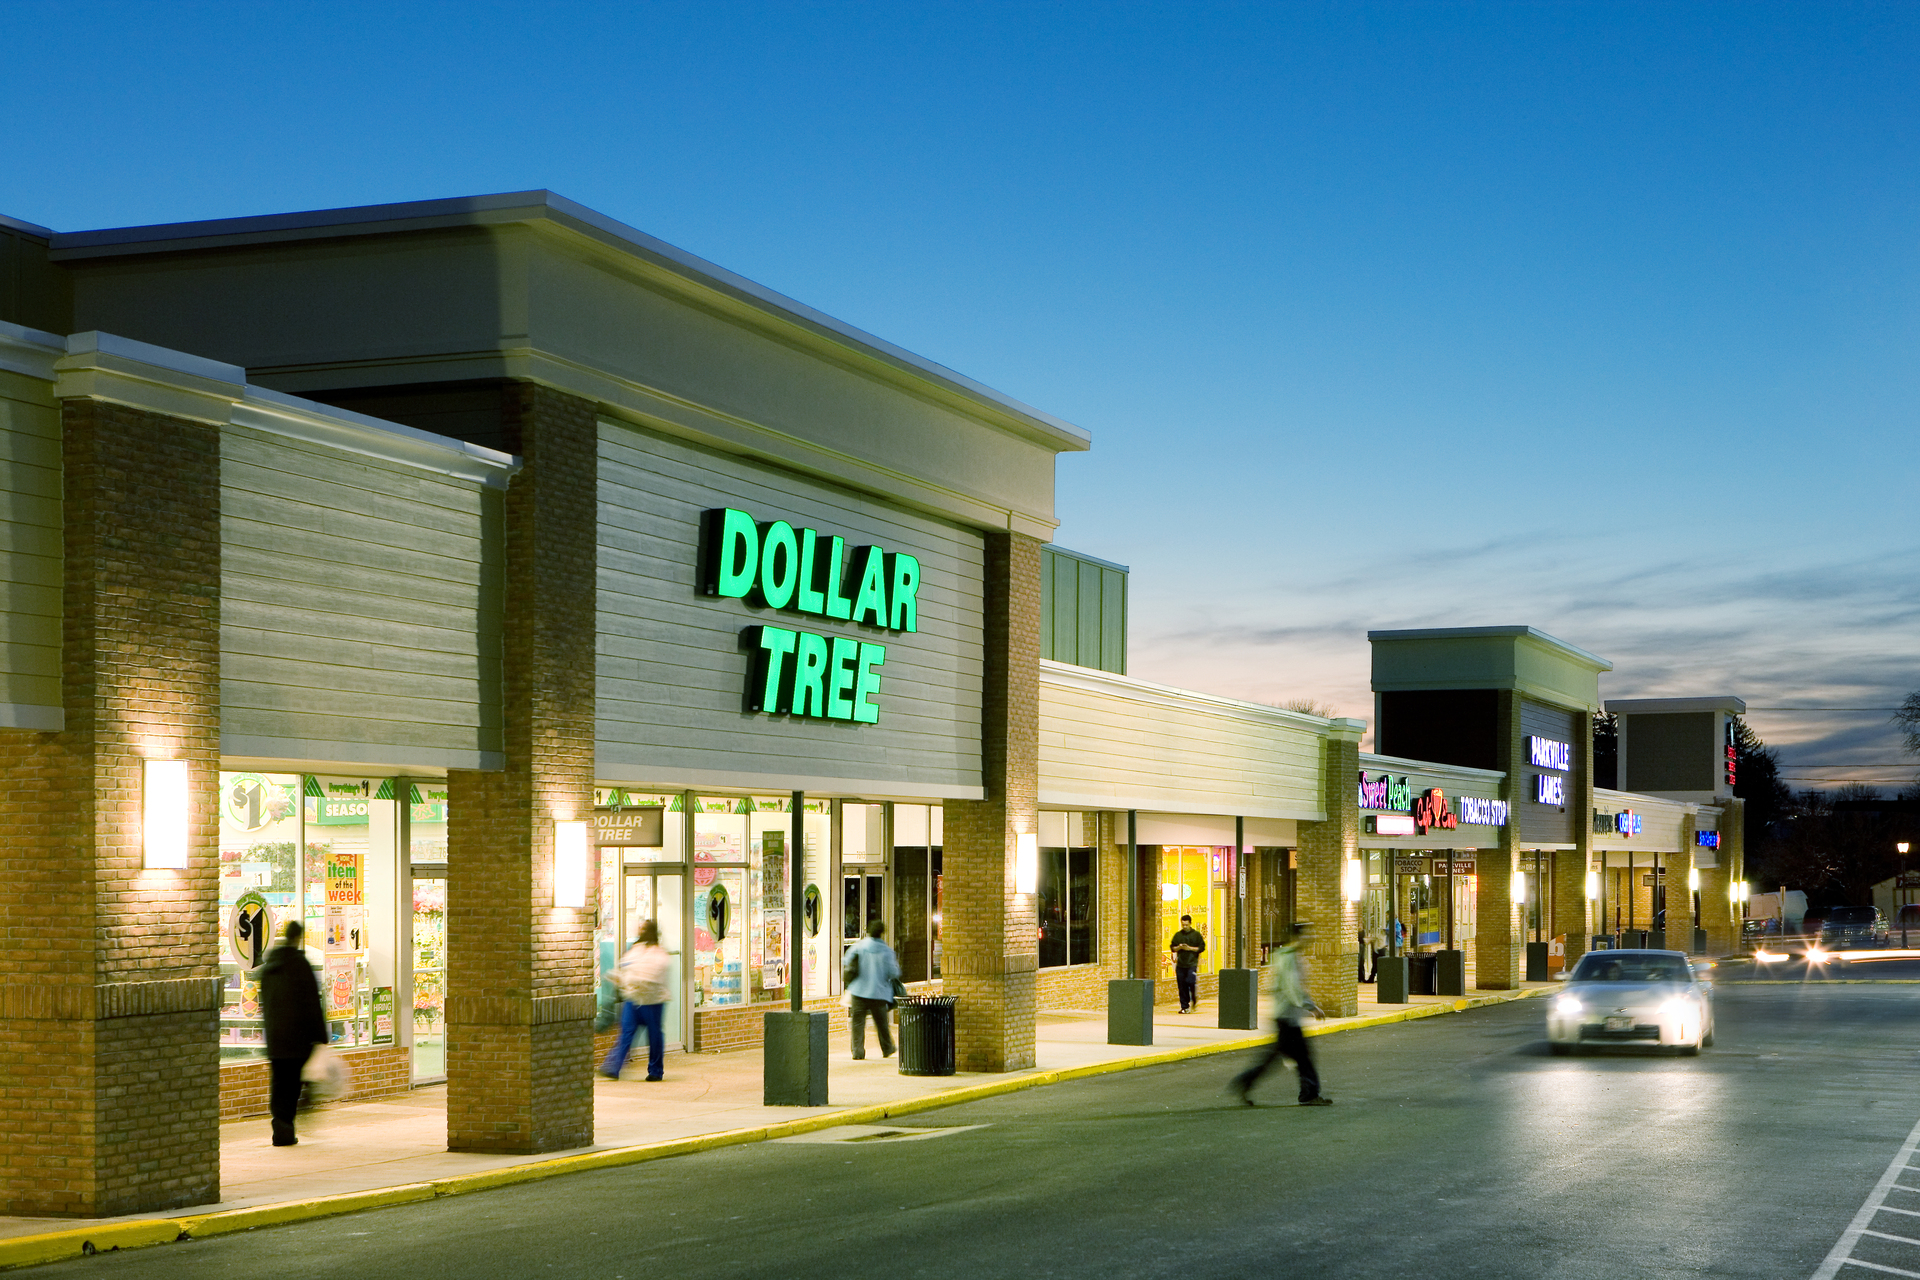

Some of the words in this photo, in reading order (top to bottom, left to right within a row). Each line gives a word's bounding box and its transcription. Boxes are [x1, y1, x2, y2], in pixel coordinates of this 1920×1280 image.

[718, 507, 921, 633] DOLLAR
[760, 625, 886, 724] TREE
[1531, 735, 1570, 772] PARKVILLE
[1363, 771, 1387, 809] Sweet
[1387, 774, 1411, 811] Peach
[1538, 774, 1563, 806] LANES
[232, 782, 262, 830] $1
[325, 803, 369, 816] SEASO
[1460, 796, 1490, 825] TOBACCO
[1491, 799, 1507, 826] STOP
[598, 828, 632, 841] TREE
[327, 860, 357, 878] item
[335, 880, 342, 889] of
[342, 880, 354, 889] the
[328, 889, 362, 902] week
[711, 896, 726, 942] $1
[805, 894, 818, 938] $1
[238, 907, 266, 969] $1
[350, 928, 360, 951] $1
[373, 1002, 392, 1012] HIRING
[379, 994, 392, 1003] NOW
